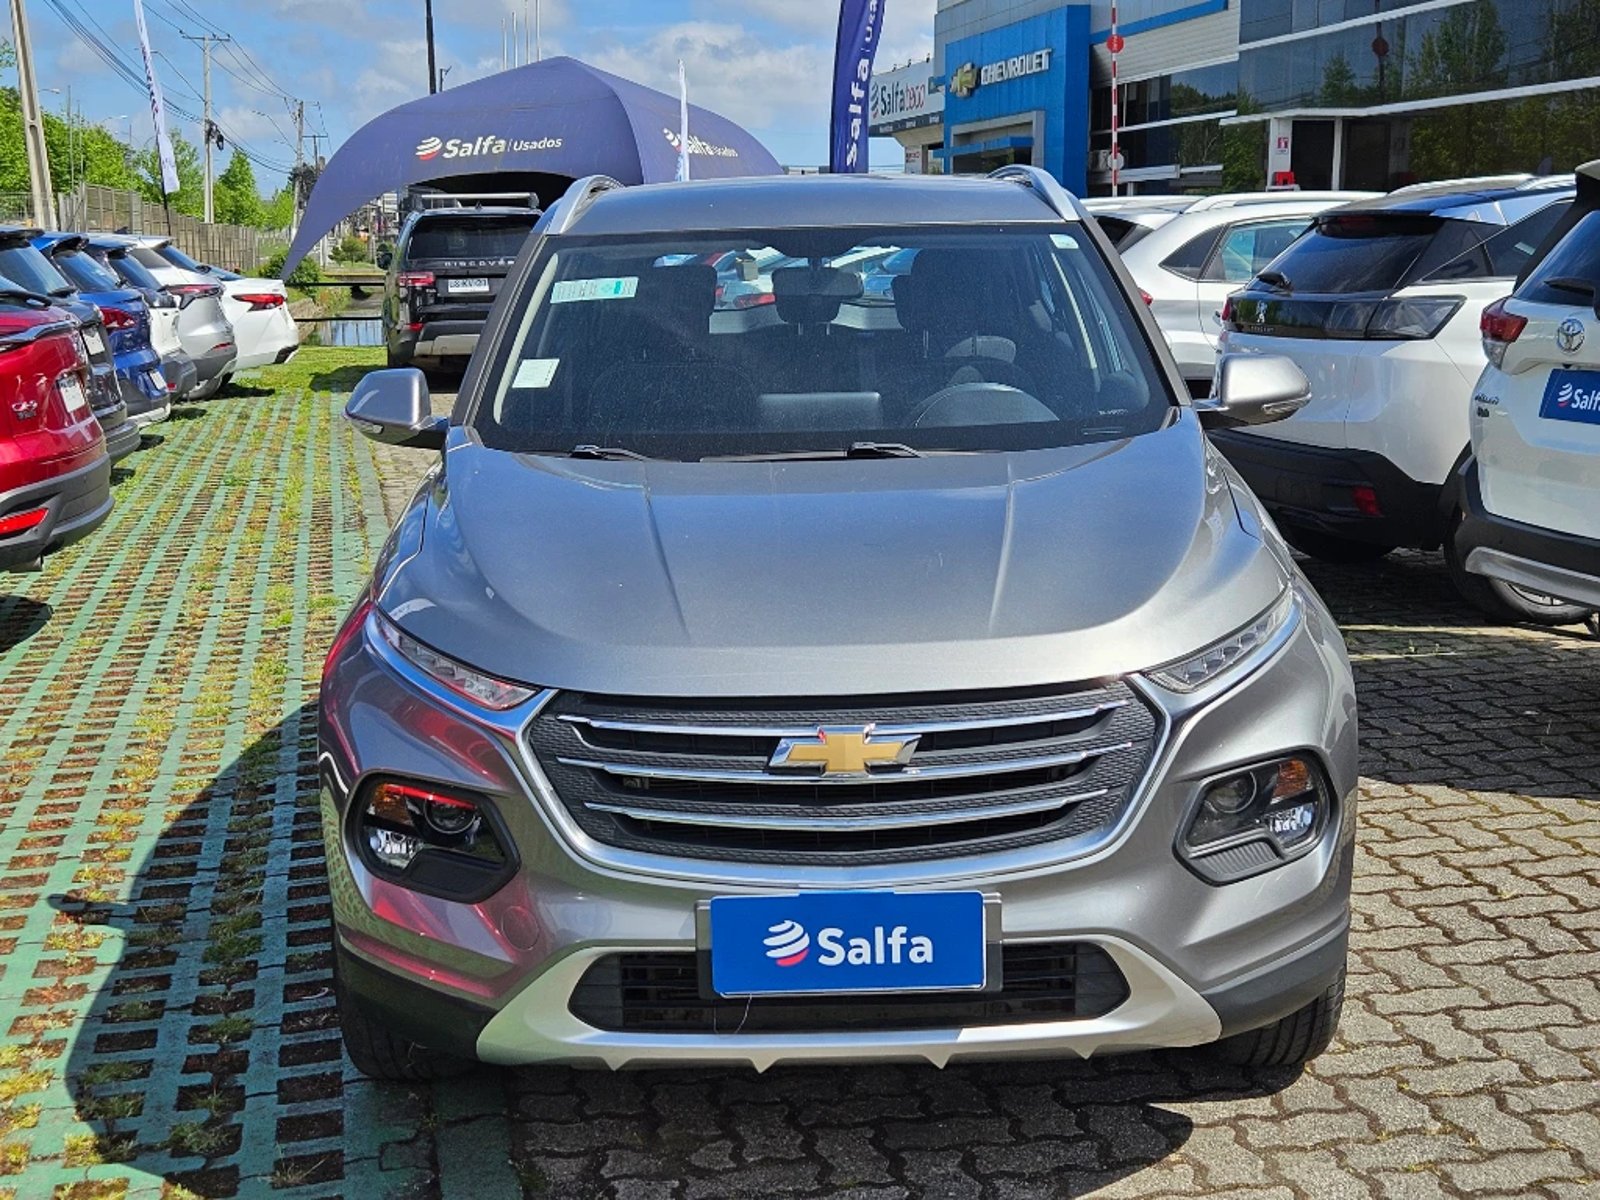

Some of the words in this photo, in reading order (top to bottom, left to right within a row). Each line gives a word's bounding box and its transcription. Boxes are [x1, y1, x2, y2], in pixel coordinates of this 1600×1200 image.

[981, 48, 1052, 86] CHEVROLET
[846, 58, 870, 168] Salfa
[442, 135, 507, 159] Salfa
[513, 137, 563, 152] Usados
[1571, 388, 1600, 411] Salf
[817, 926, 934, 966] Salfa
